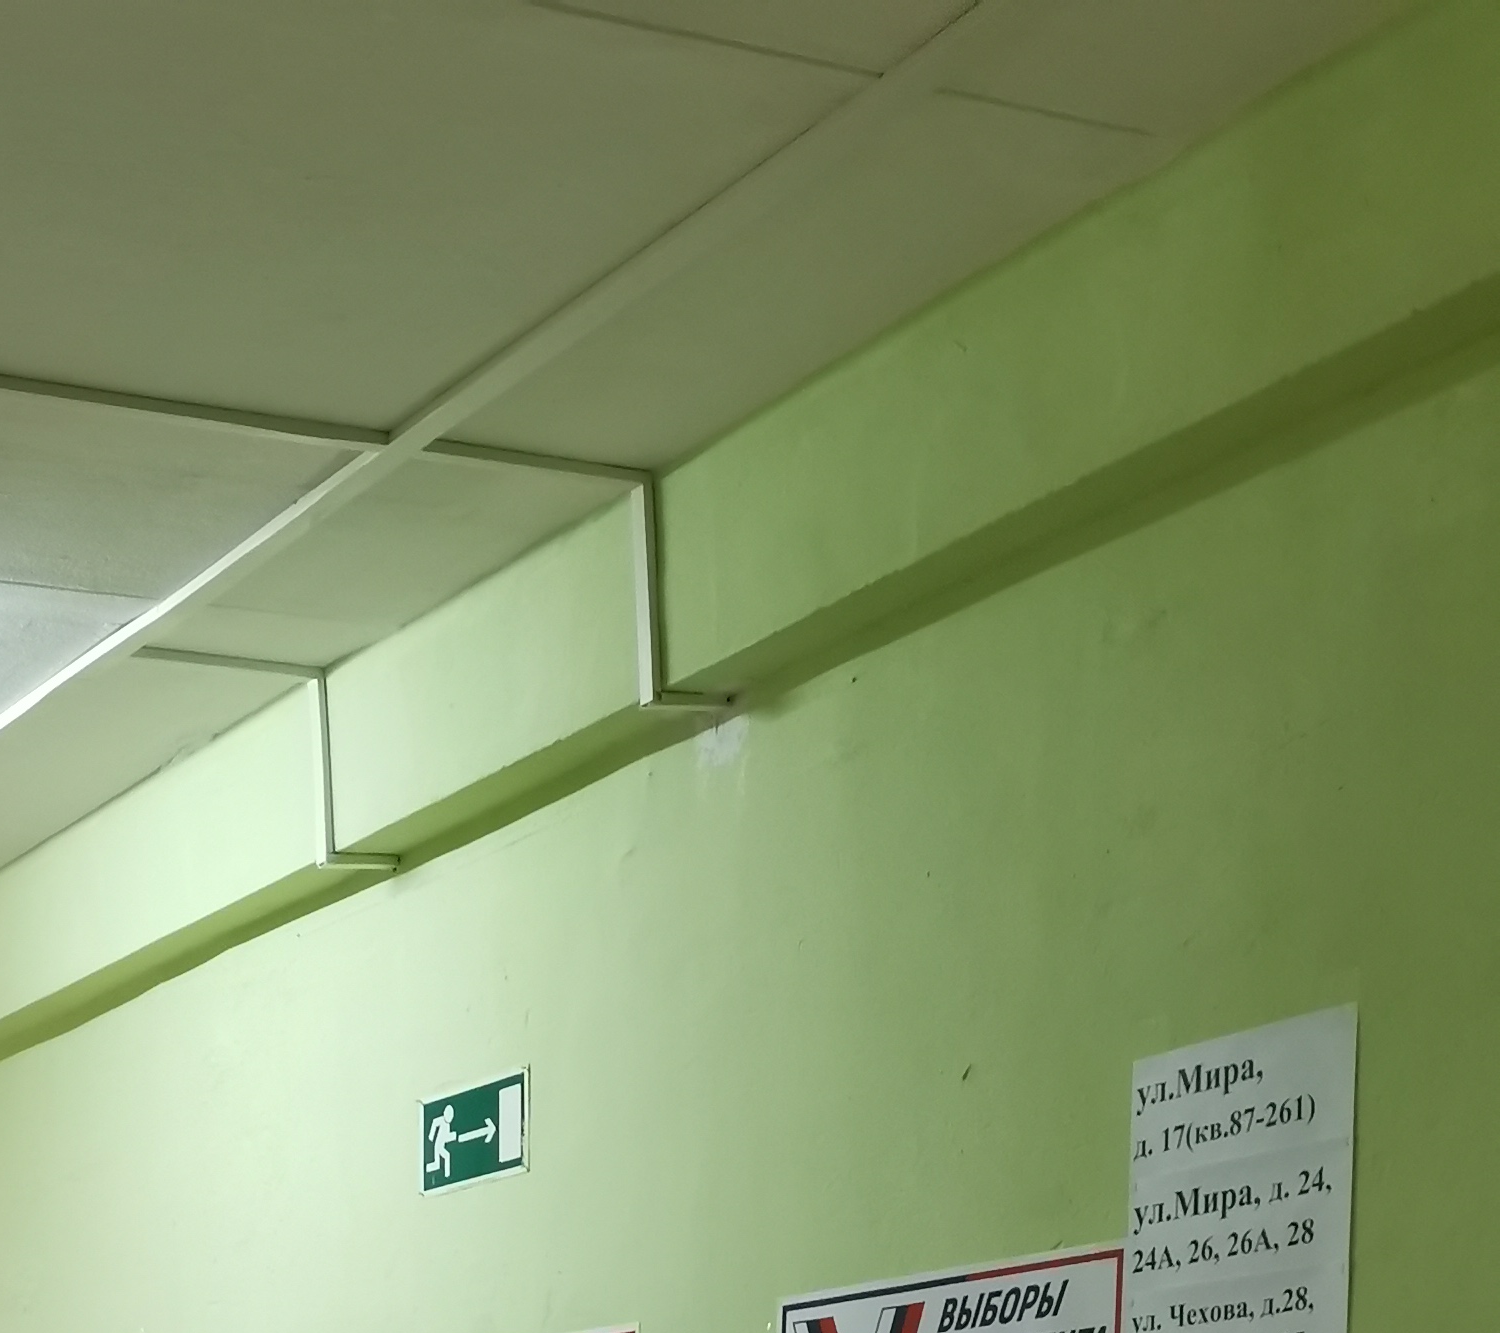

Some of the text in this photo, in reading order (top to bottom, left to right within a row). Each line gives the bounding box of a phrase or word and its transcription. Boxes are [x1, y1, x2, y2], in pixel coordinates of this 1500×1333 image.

[1135, 1055, 1264, 1115] ул.Мира,
[1133, 1093, 1316, 1162] д. 17(кв.87-261)
[1133, 1165, 1333, 1235] ул.Мира, д. 24,
[1187, 1239, 1220, 1266] 26,
[1287, 1218, 1315, 1246] 28
[937, 1279, 1070, 1333] ВЫБОРЫ
[1168, 1294, 1255, 1329] Чехова,
[1260, 1286, 1315, 1320] д.28,
